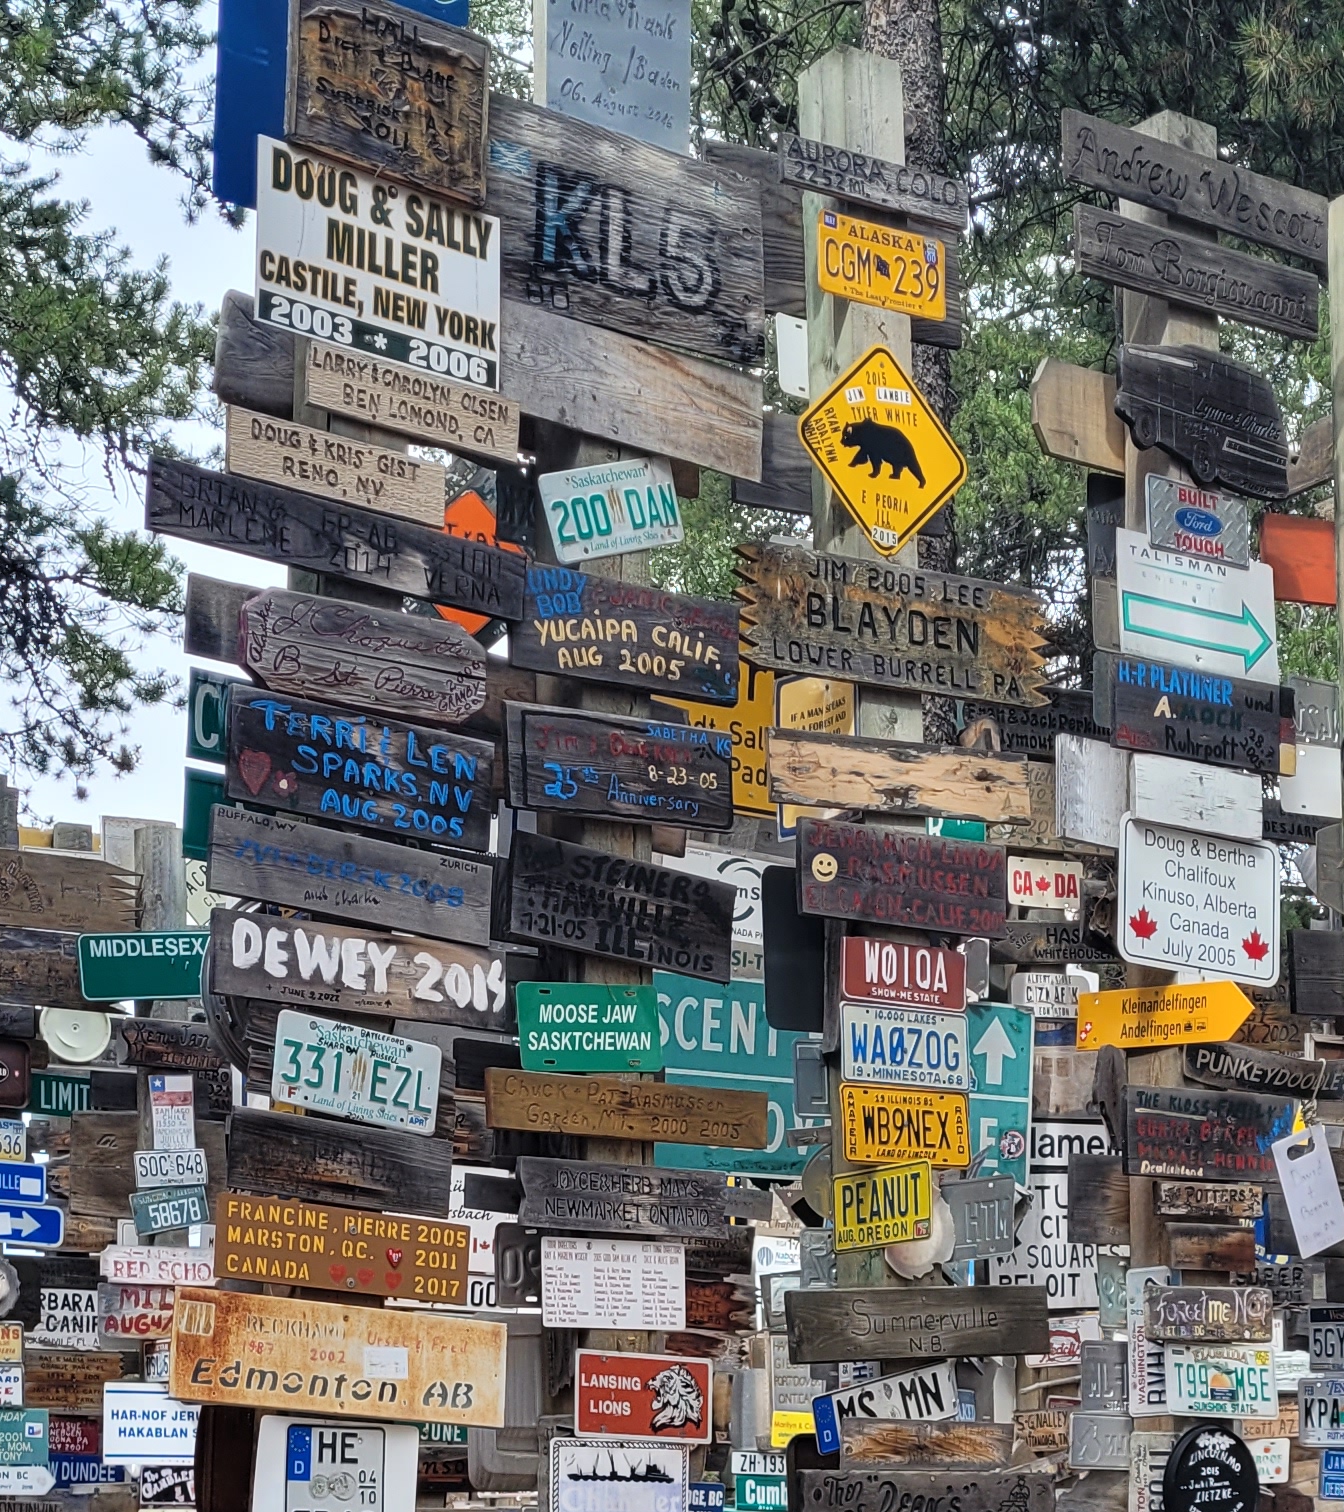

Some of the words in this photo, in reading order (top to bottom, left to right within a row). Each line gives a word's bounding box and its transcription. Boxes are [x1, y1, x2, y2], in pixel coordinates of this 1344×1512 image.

[1073, 128, 1189, 199] Andrew
[272, 148, 358, 217] DOUG
[407, 195, 492, 261] SALLY
[848, 223, 917, 254] ALASKA
[326, 219, 440, 294] MILLER
[825, 239, 874, 278] CGM
[893, 255, 938, 300] 239
[260, 249, 364, 319] CASTILE,
[373, 285, 428, 334] NEW
[436, 304, 496, 353] YORK
[270, 300, 353, 344] 2003
[408, 338, 489, 384] 2006
[282, 457, 338, 492] RENO,
[377, 455, 421, 482] GIST
[571, 467, 646, 488] Saskatchewan
[551, 498, 610, 543] 200
[631, 484, 676, 527] DAN
[1130, 544, 1226, 576] TALISMAN
[1175, 531, 1225, 557] TOUGH
[807, 592, 979, 656] BLAYDEN
[559, 646, 603, 669] AUG
[619, 653, 685, 681] 2005
[773, 638, 855, 672] LOWER
[874, 655, 972, 691] BURRELL
[293, 746, 423, 797] SPARKS,
[1145, 829, 1186, 859] Doug
[1207, 843, 1257, 868] Bertha
[1165, 860, 1236, 890] Chalifoux
[1142, 882, 1200, 914] Kinuso,
[1205, 893, 1257, 919] Alberta
[1170, 915, 1230, 940] Canada
[90, 939, 204, 957] MIDDLESEX
[233, 918, 395, 993] DEWEY
[1163, 936, 1194, 966] July
[1199, 943, 1236, 967] 2005
[539, 1005, 597, 1024] MOOSE
[602, 1005, 637, 1023] JAW
[1122, 995, 1207, 1016] Kleinandelfingen
[528, 1033, 651, 1051] SASKTCHEWAN
[1121, 1022, 1182, 1039] Andelfingen
[281, 1041, 342, 1089] 331
[371, 1062, 431, 1113] EZL
[862, 1107, 950, 1149] WB9NEX
[843, 1175, 920, 1224] PEANUT
[858, 1223, 908, 1244] OREGON
[225, 1257, 311, 1281] CANADA
[415, 1277, 460, 1297] 2017
[415, 1249, 457, 1270] 2011
[852, 1301, 998, 1336] Summerville
[192, 1357, 407, 1406] Edmonton,
[422, 1382, 473, 1409] AB
[582, 1373, 641, 1390] LANSING
[590, 1400, 631, 1415] LIONS
[318, 1431, 358, 1464] HE
